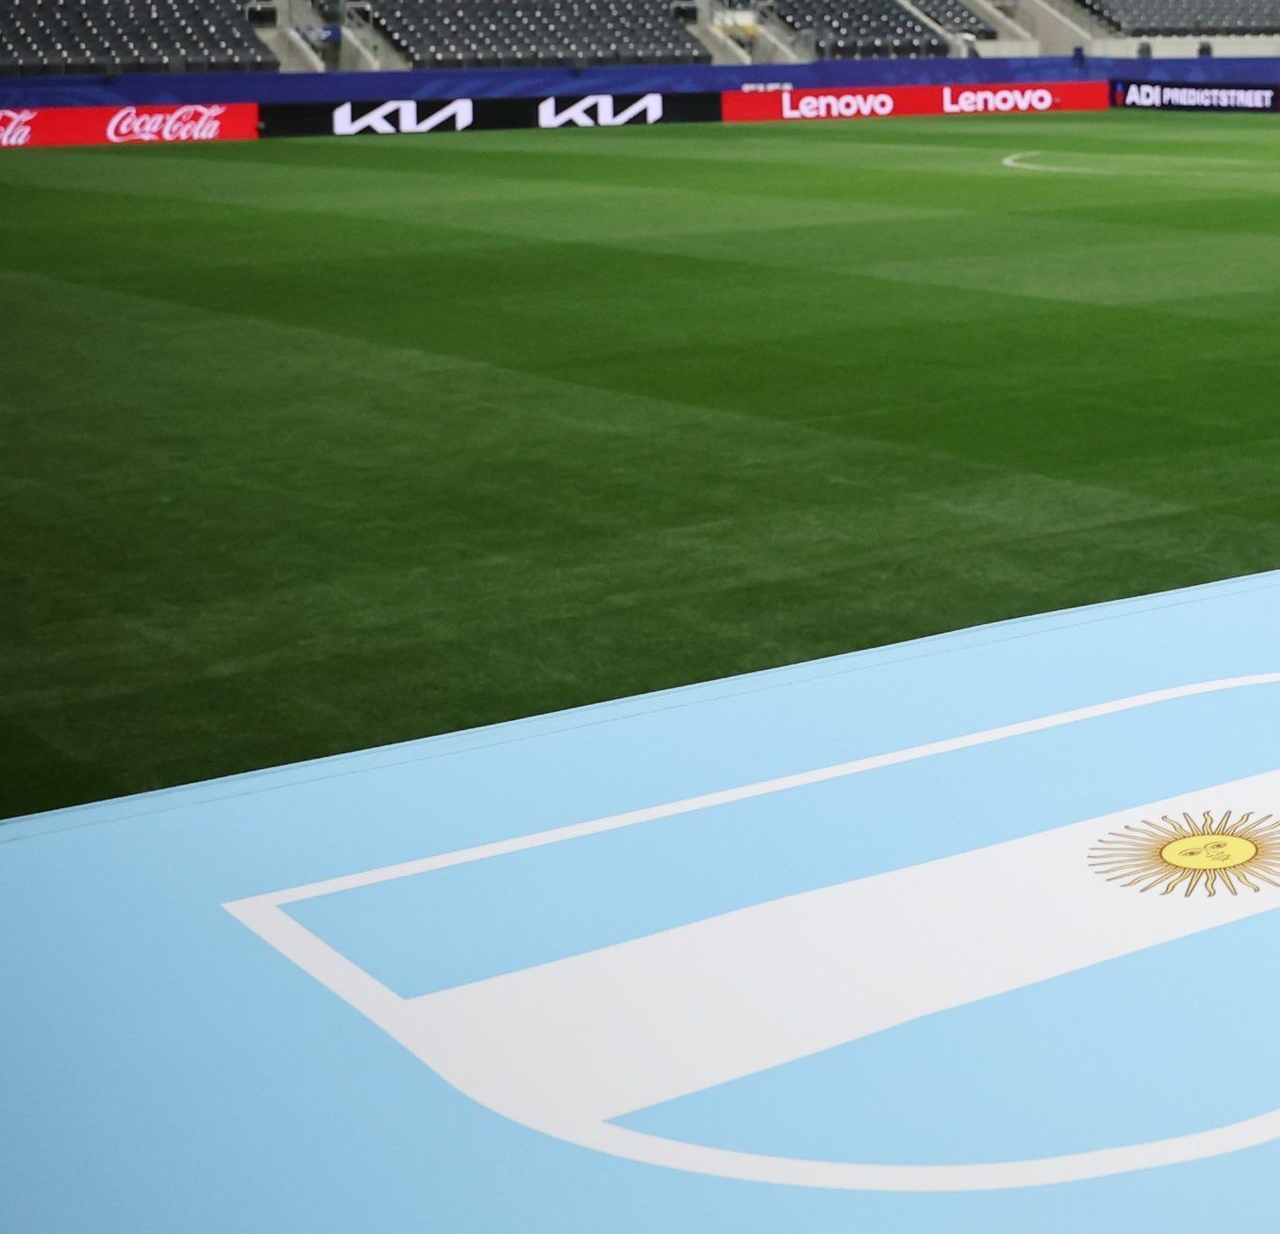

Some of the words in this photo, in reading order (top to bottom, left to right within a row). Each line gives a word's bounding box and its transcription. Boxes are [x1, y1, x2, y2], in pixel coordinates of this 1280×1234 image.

[333, 98, 473, 135] KIA
[538, 93, 663, 129] KIA
[781, 91, 893, 119] Lenovo
[943, 87, 1053, 114] Lenovo
[106, 104, 227, 144] Coca-Cola
